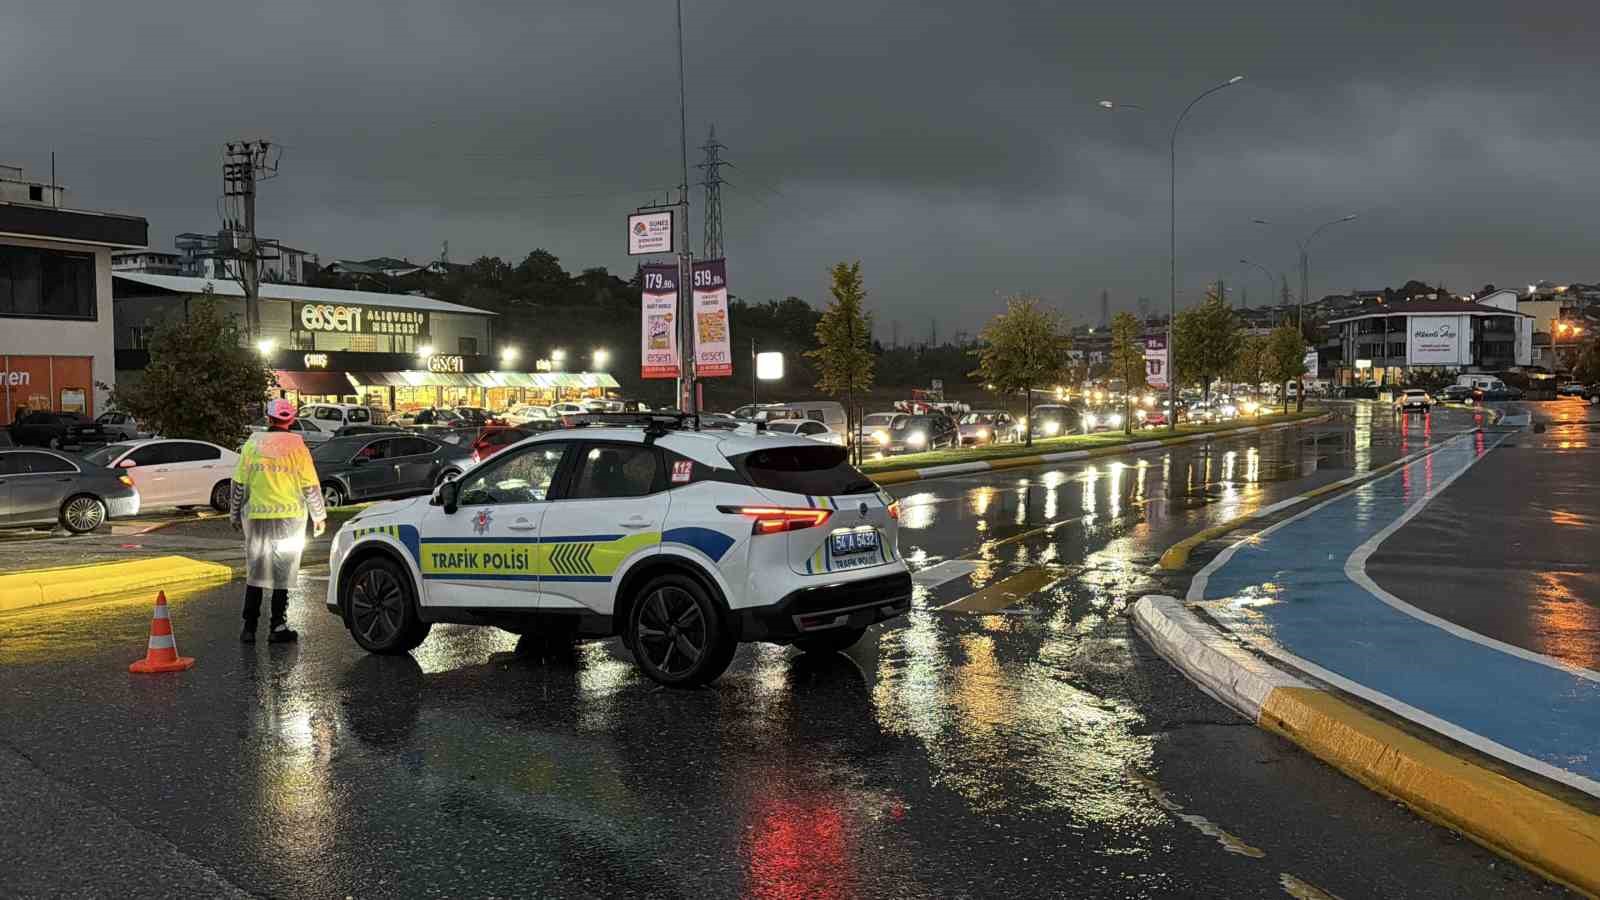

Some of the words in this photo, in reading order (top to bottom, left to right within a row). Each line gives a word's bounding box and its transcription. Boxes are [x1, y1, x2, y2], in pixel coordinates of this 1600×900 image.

[301, 303, 362, 332] essen
[673, 460, 692, 474] 112
[432, 548, 478, 569] TRAFİK
[483, 548, 529, 570] POLİSİ
